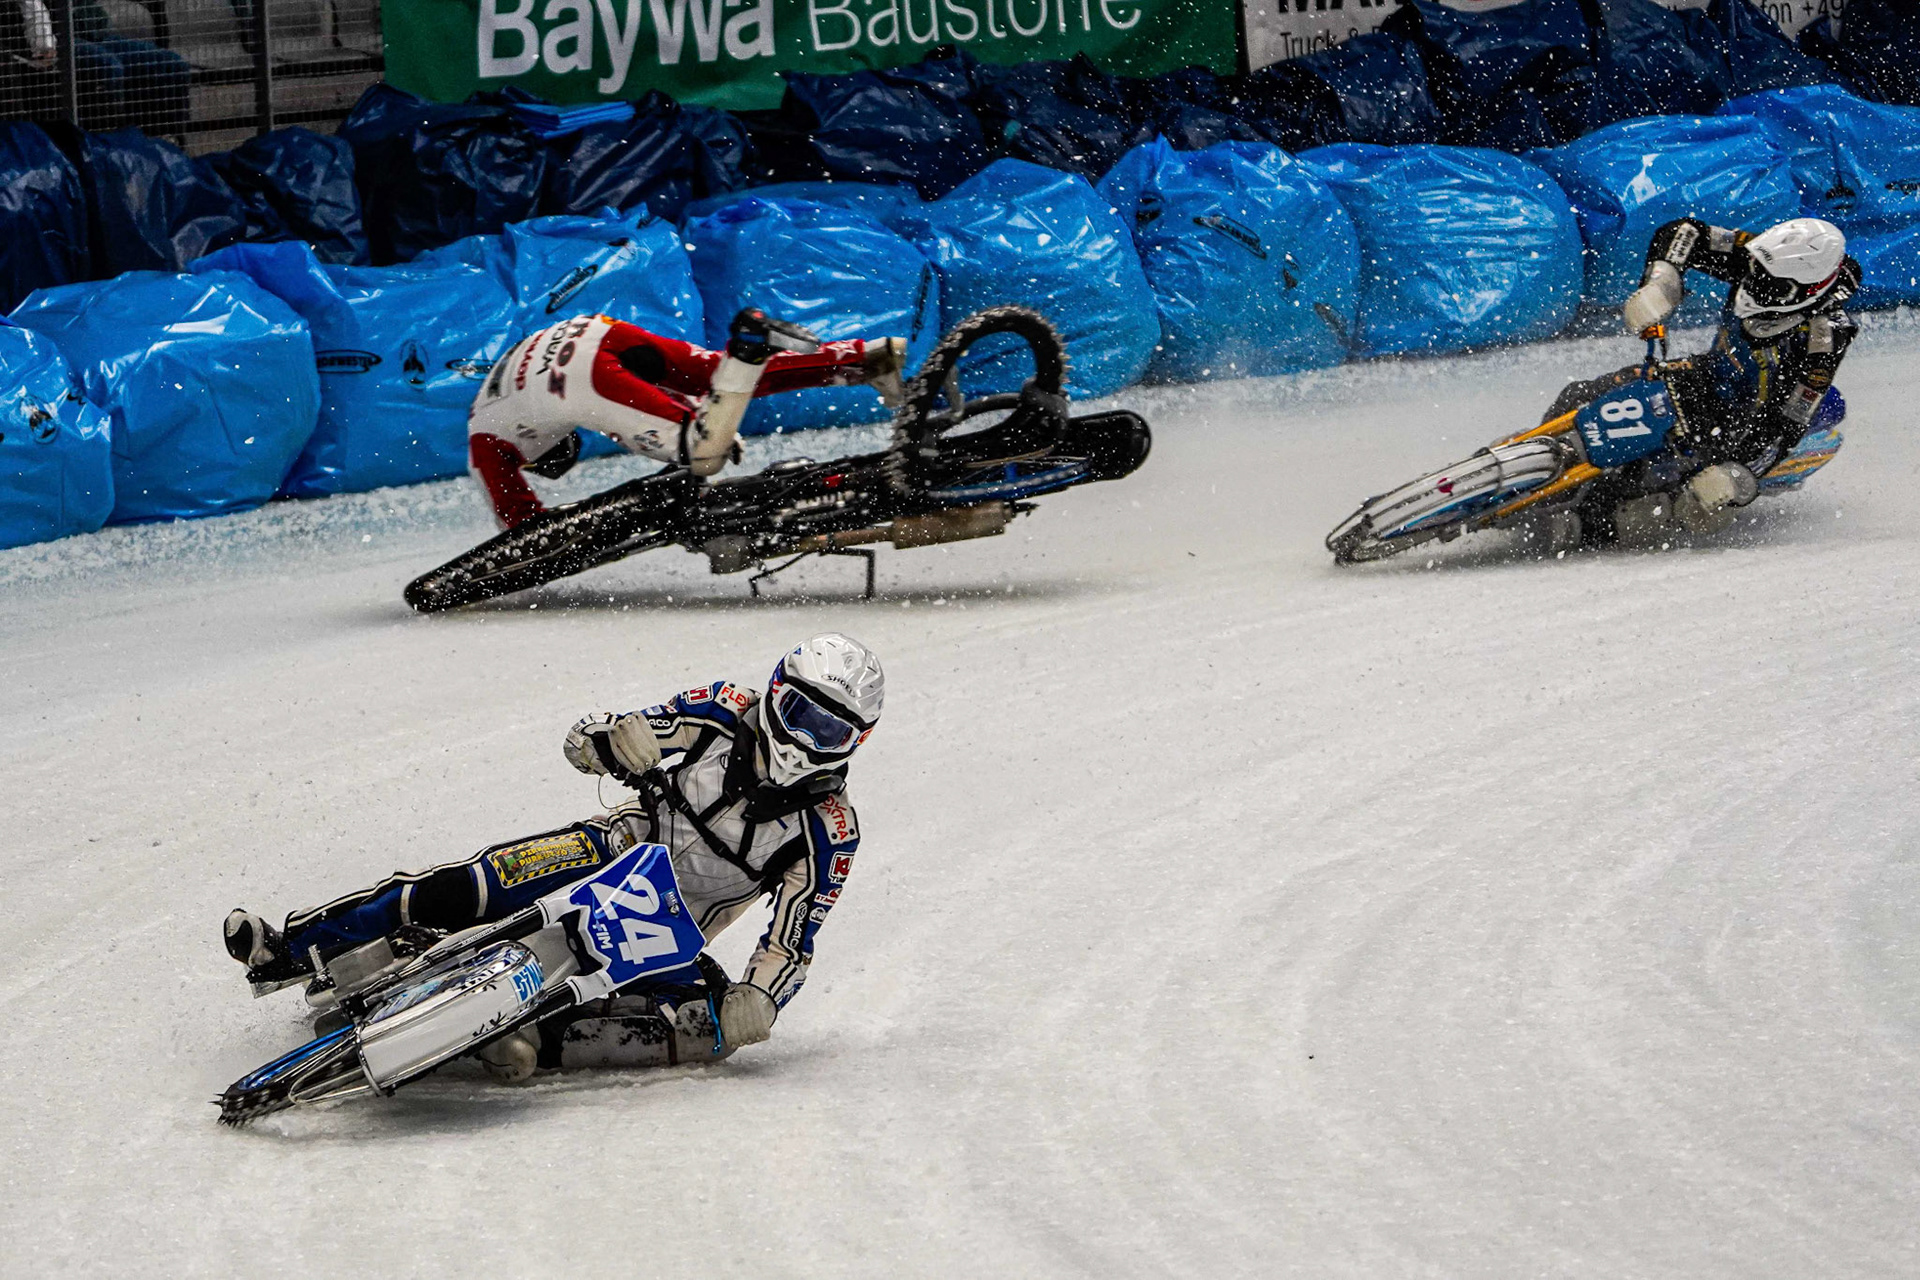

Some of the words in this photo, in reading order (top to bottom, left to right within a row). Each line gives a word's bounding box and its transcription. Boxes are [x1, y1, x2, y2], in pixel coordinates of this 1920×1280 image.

[1583, 421, 1604, 448] FIM
[1601, 398, 1652, 439] 81
[591, 874, 679, 965] 24
[592, 923, 614, 950] FIM
